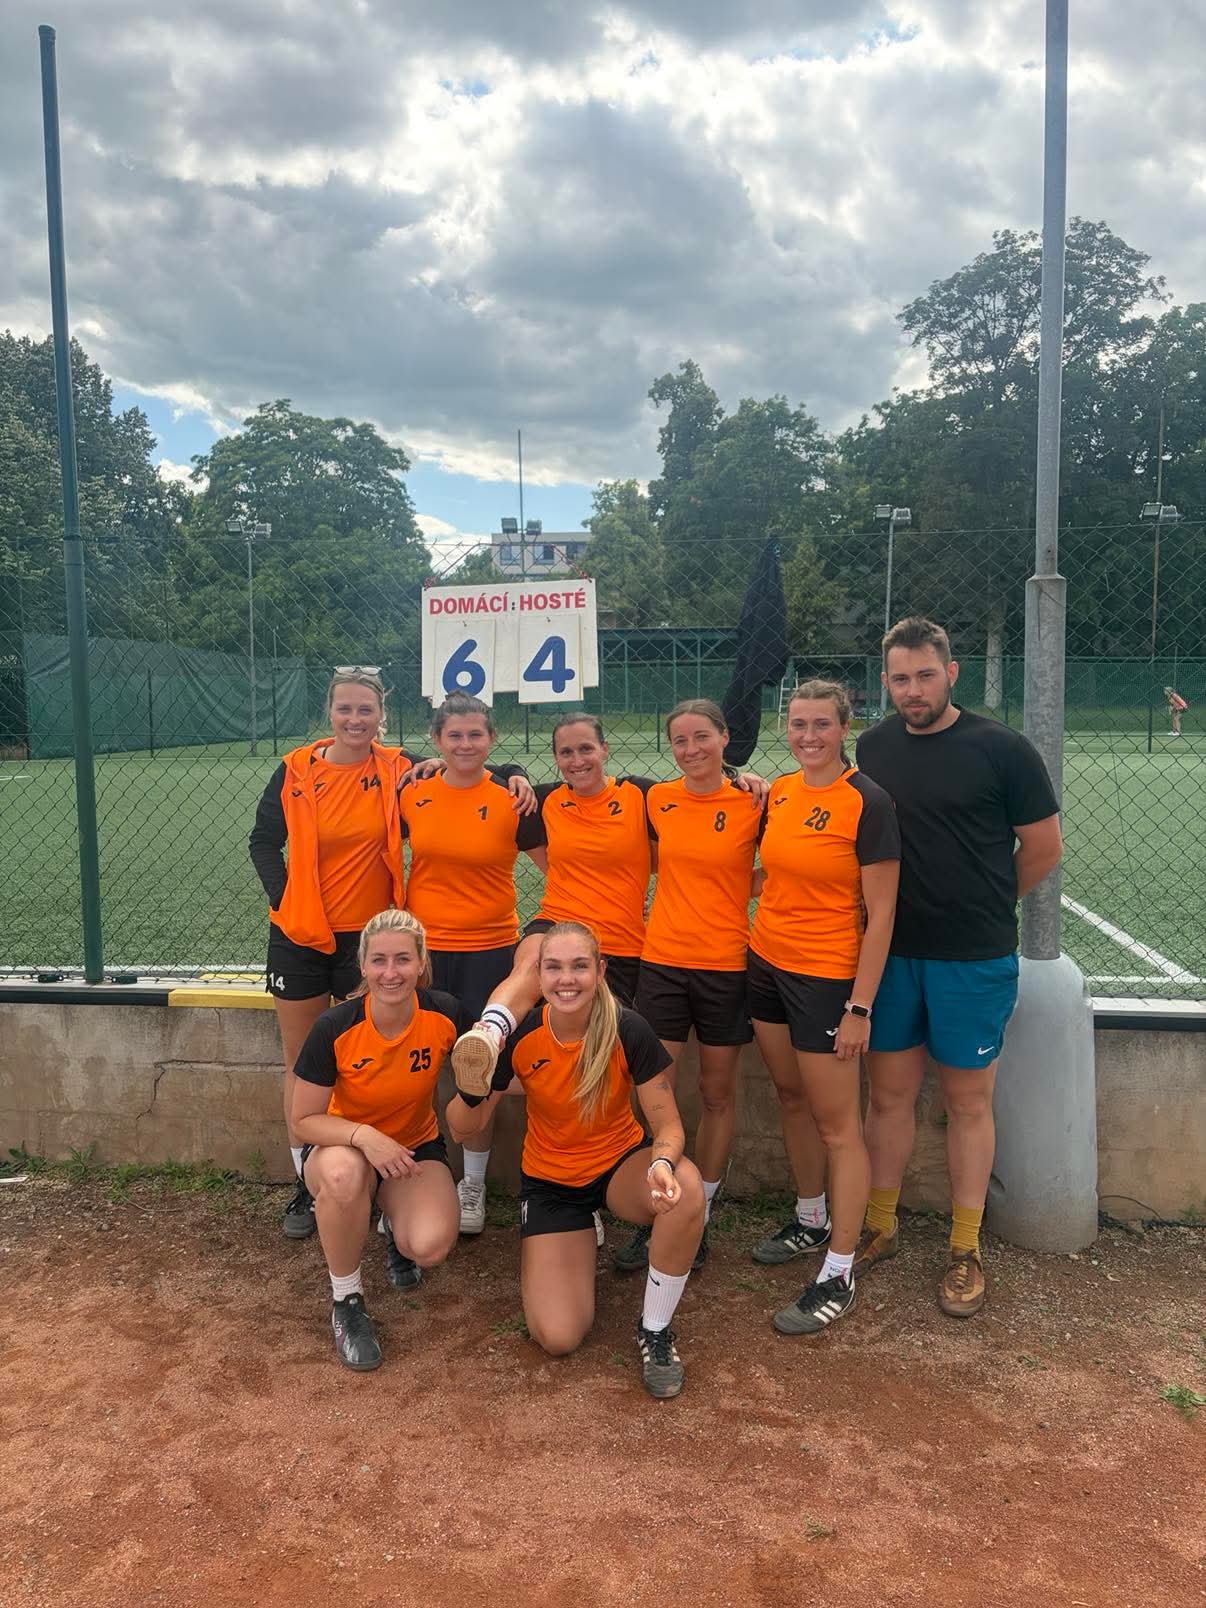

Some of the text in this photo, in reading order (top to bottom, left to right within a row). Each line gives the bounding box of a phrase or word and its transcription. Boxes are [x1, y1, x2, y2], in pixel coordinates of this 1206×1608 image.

[429, 592, 509, 615] DOMÁCÍ
[519, 588, 586, 611] HOSTÉ
[442, 635, 576, 698] 6 4
[360, 773, 381, 792] 14
[478, 805, 488, 821] 1
[608, 800, 622, 817] 2
[804, 806, 831, 832] 28
[713, 811, 727, 833] 8
[269, 972, 286, 991] 14
[409, 1047, 432, 1073] 25
